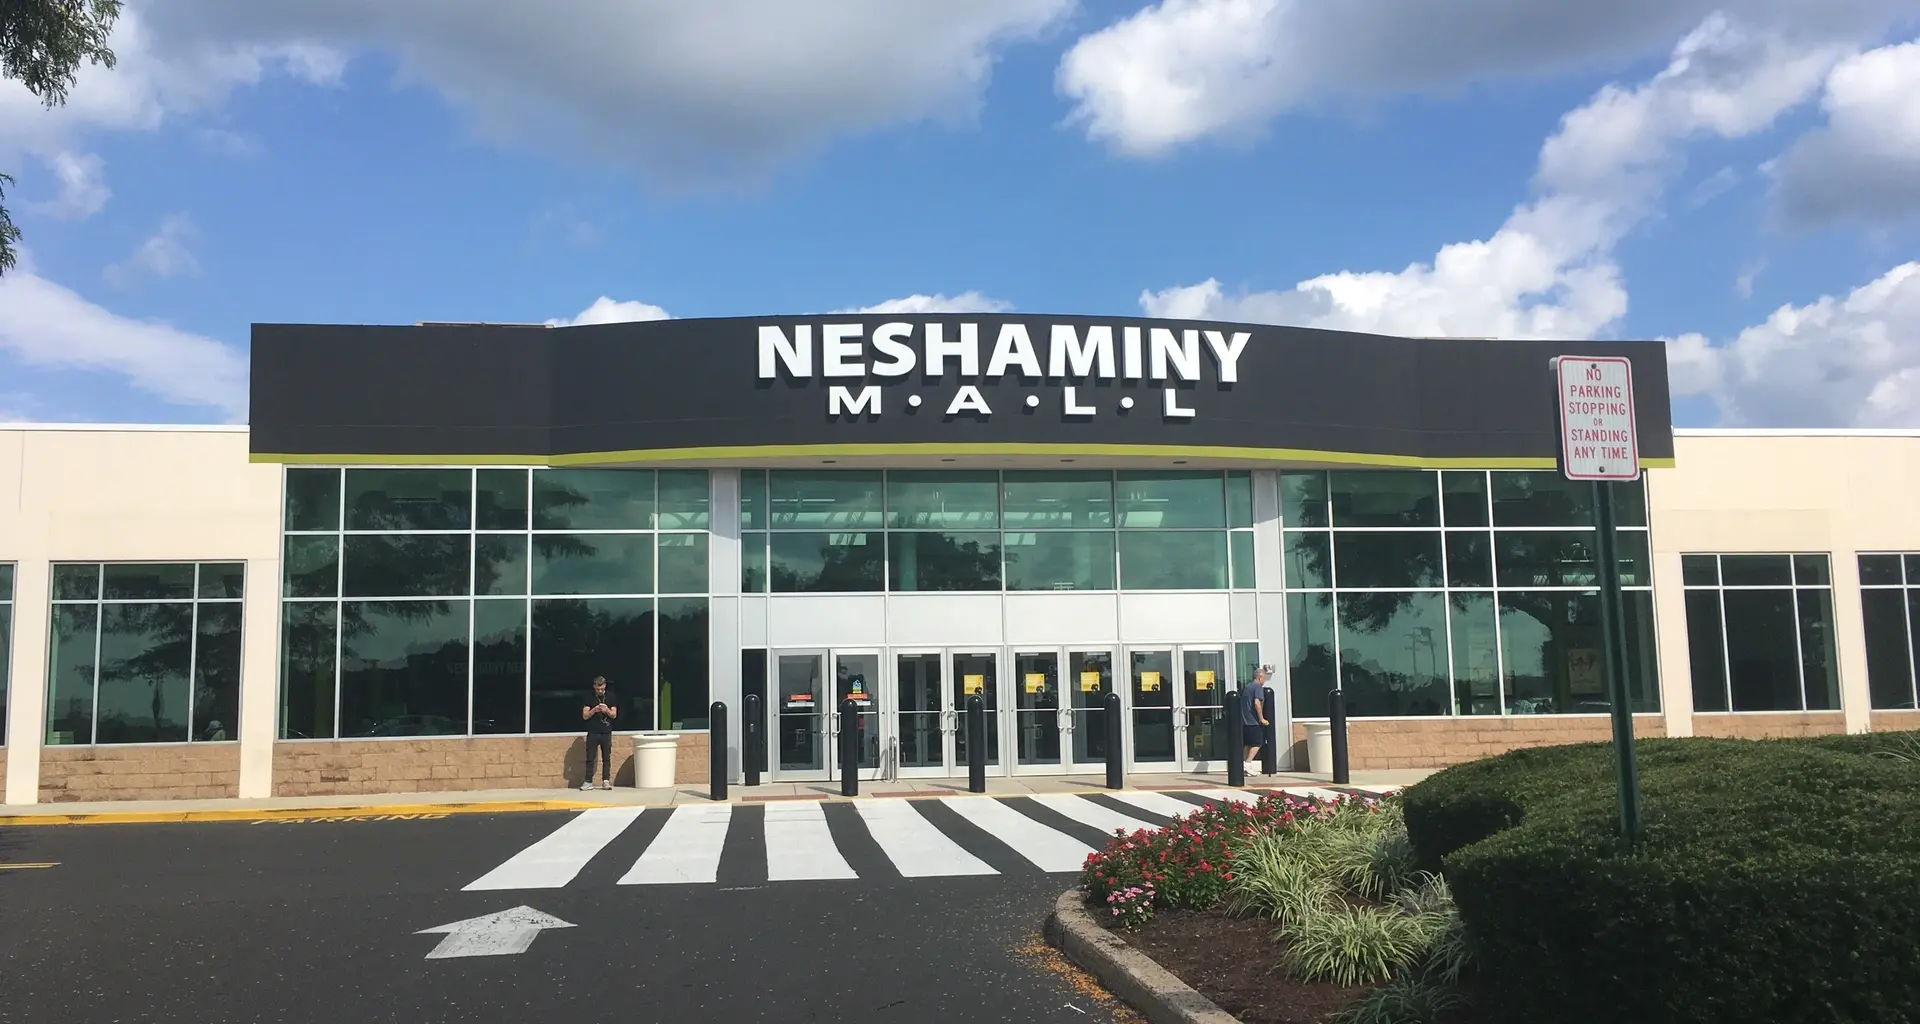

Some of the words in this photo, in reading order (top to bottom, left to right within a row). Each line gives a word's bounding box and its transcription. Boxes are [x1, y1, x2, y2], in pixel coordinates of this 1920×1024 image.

[758, 322, 1252, 383] NESHAMINY
[1586, 368, 1602, 381] NO
[1570, 385, 1621, 399] PARKING
[1568, 402, 1626, 416] STOPPING
[1593, 418, 1603, 426] OR
[1571, 429, 1628, 442] STANDING
[1574, 446, 1596, 459] ANY
[1601, 447, 1628, 459] TIME
[250, 813, 450, 825] PARKING
